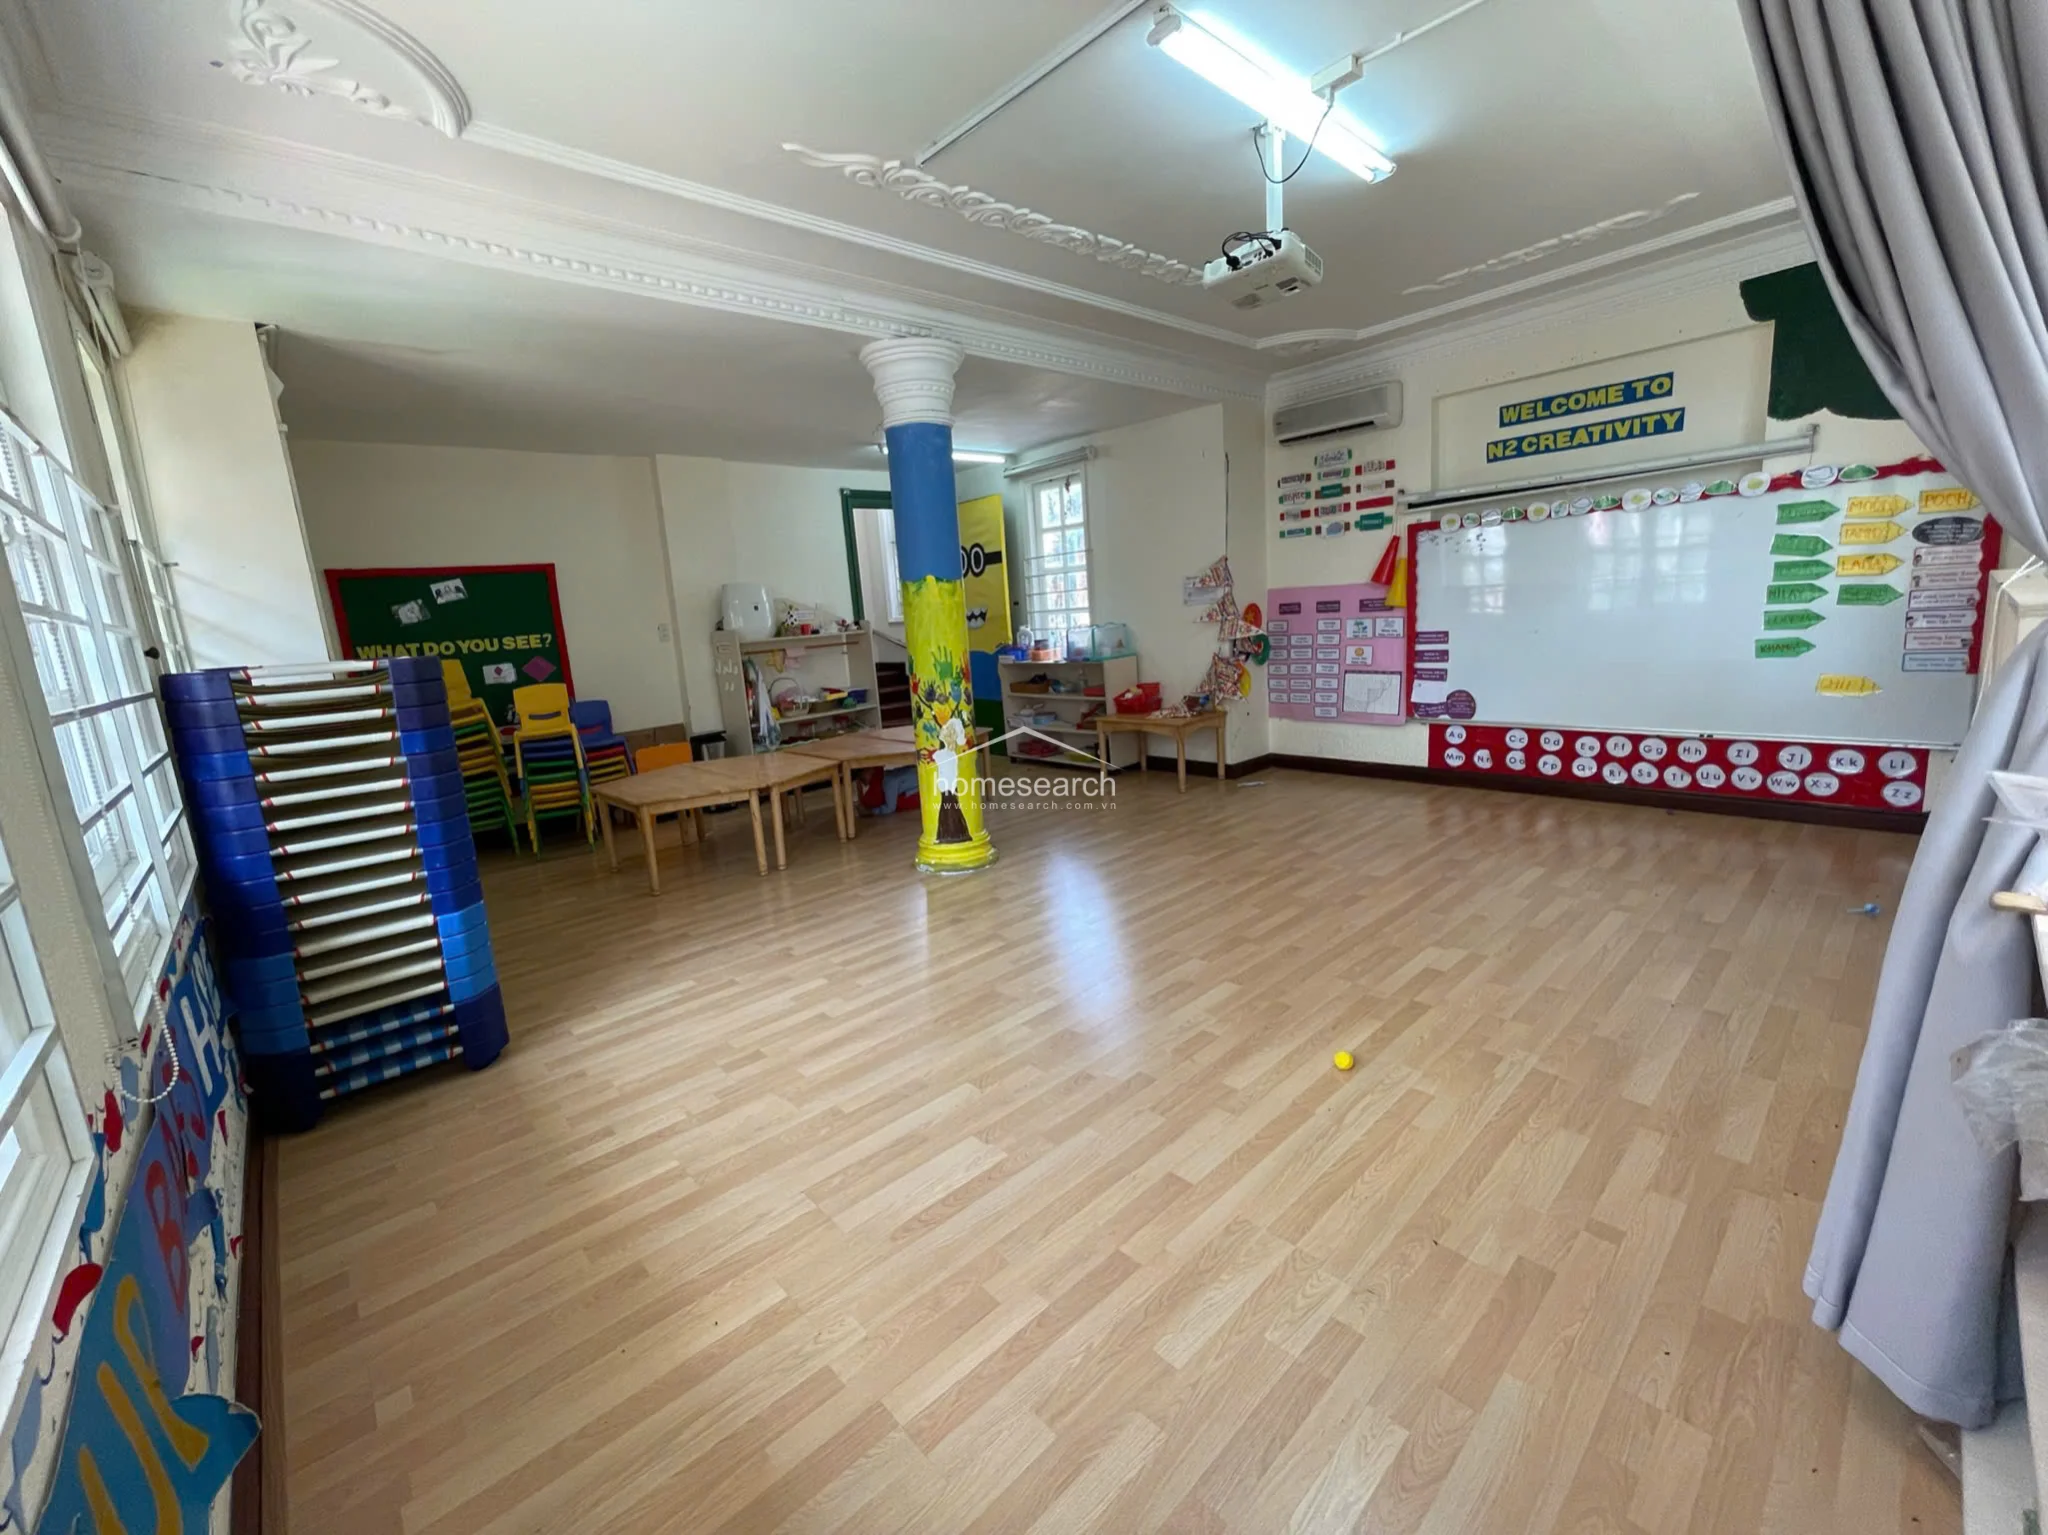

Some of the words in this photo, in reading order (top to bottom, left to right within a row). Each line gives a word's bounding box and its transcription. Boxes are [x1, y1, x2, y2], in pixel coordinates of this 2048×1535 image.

[1502, 385, 1625, 424] WELCOME
[1631, 376, 1671, 398] TO
[1488, 440, 1518, 460] N2
[1521, 410, 1681, 453] CREATIVITY
[356, 642, 420, 660] WHAT
[423, 641, 456, 657] DO
[456, 638, 500, 655] YOU
[502, 633, 552, 651] SEE?
